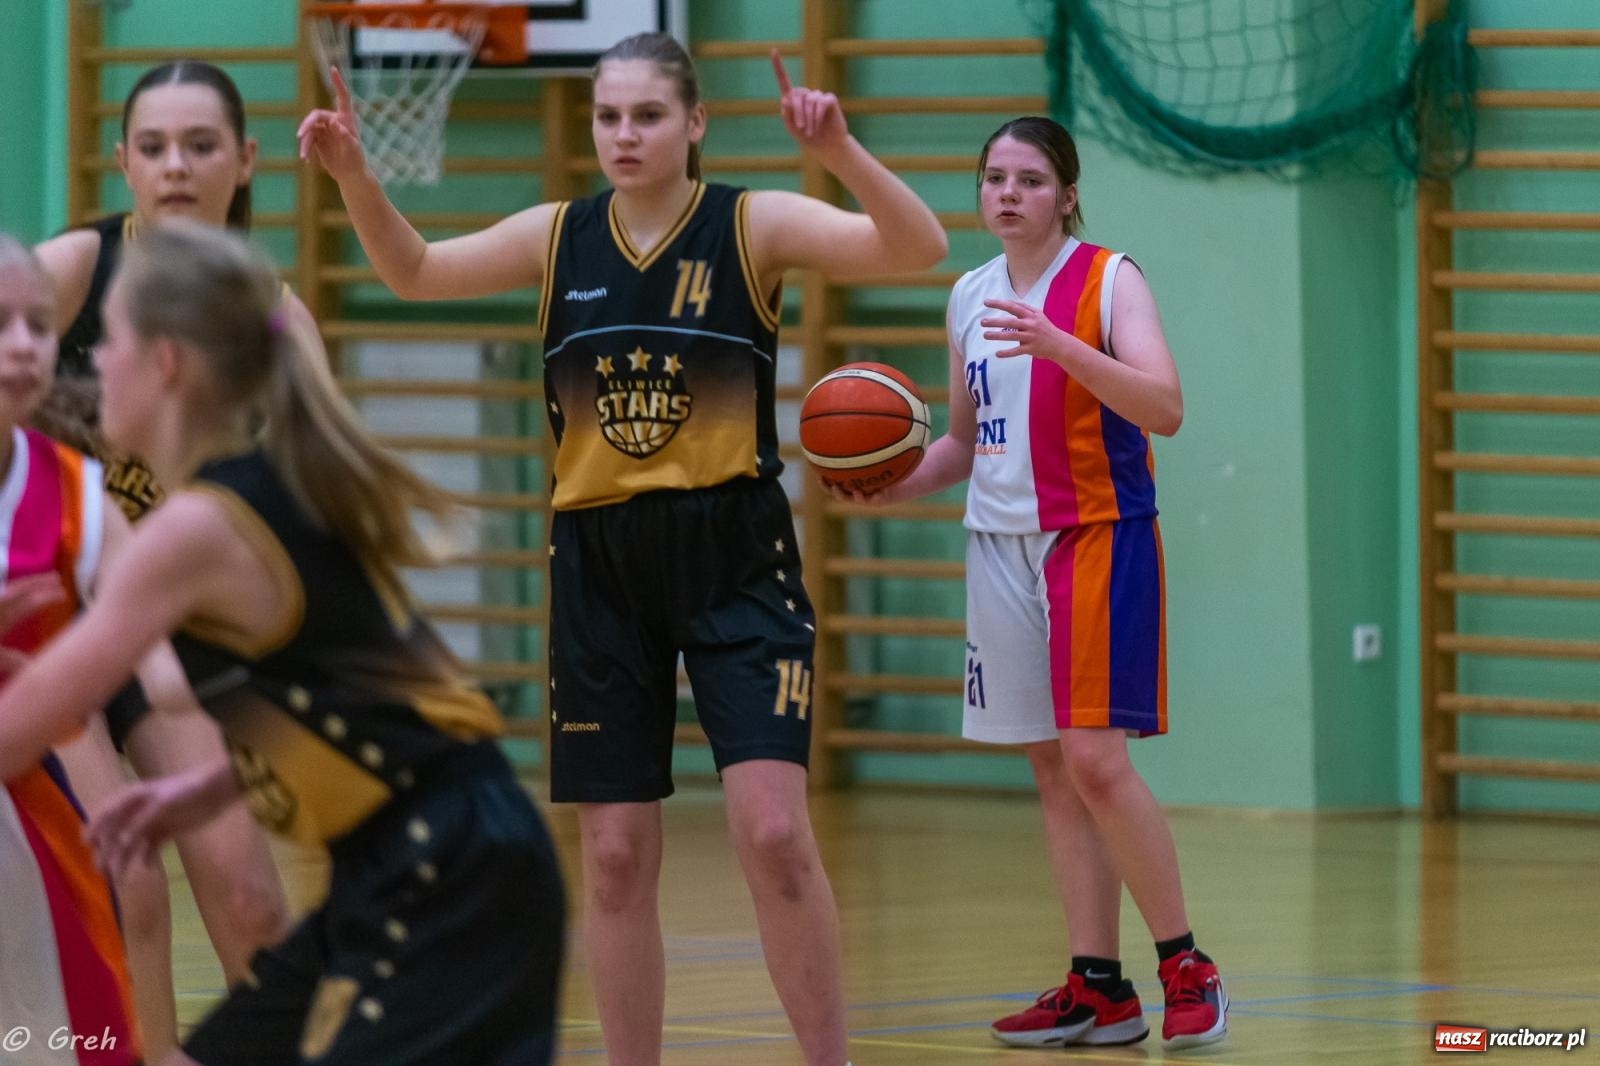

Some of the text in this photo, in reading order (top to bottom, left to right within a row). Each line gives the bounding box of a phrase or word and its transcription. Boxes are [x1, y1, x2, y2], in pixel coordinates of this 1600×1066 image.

[669, 258, 712, 318] 14
[596, 391, 691, 425] STARS
[965, 358, 992, 409] 21
[773, 658, 810, 720] 14
